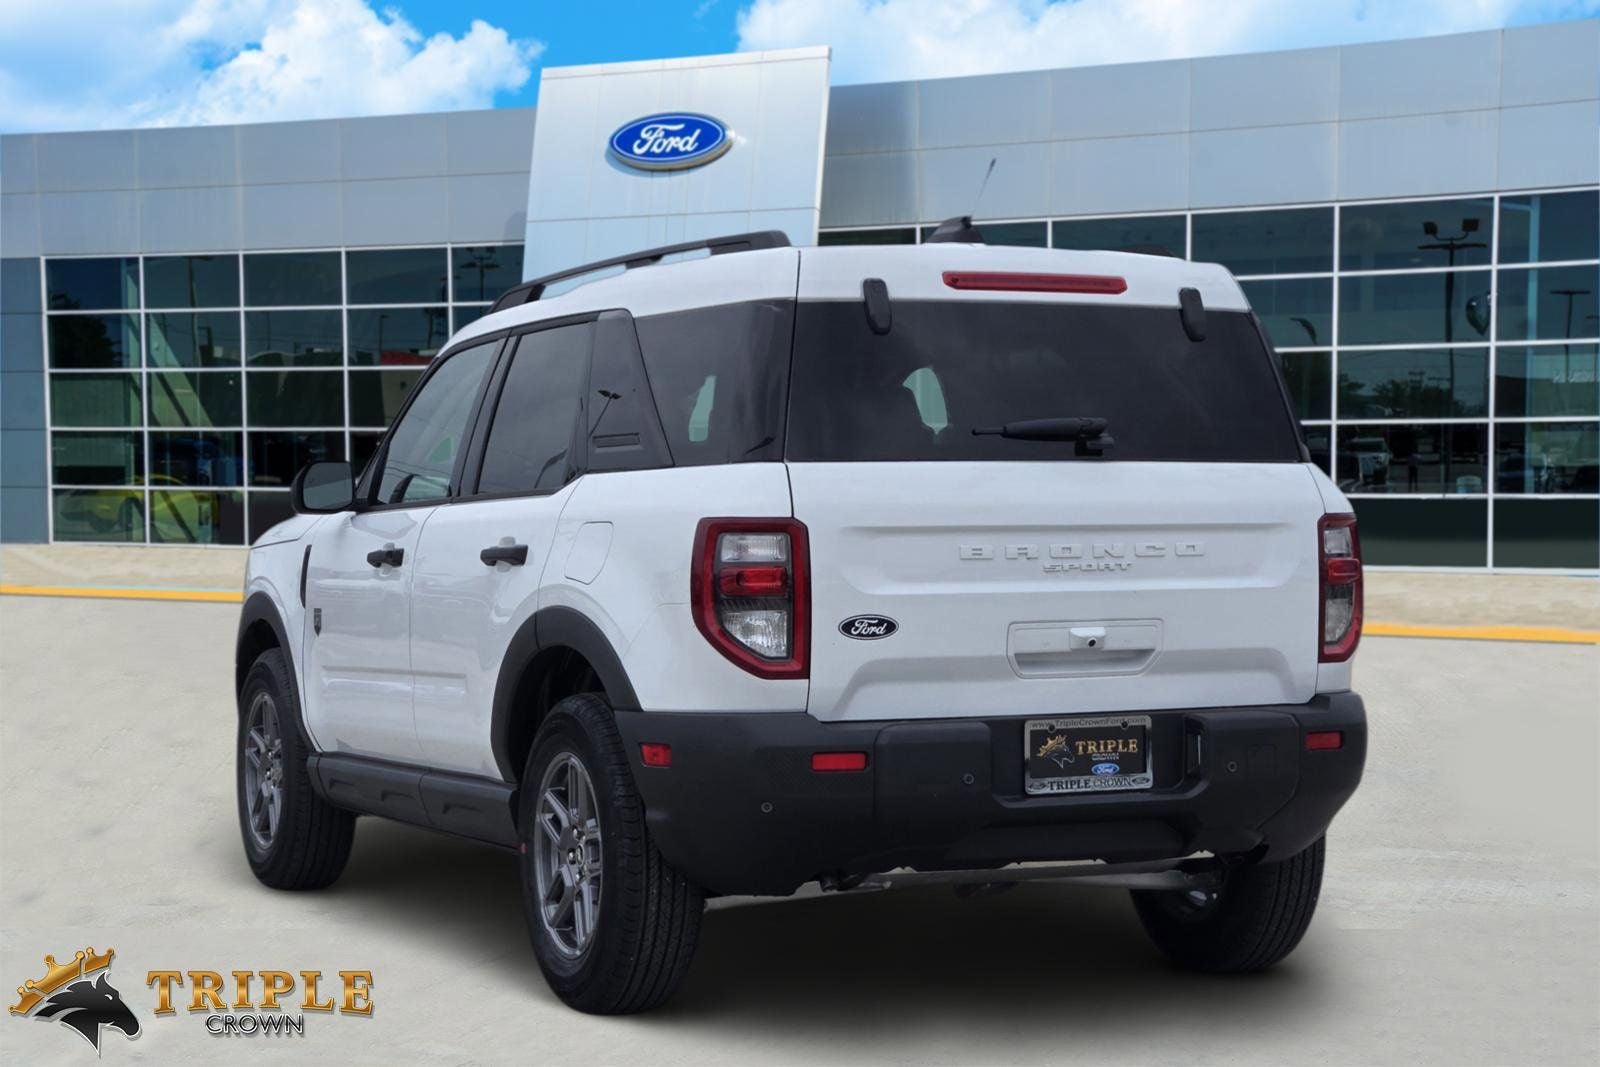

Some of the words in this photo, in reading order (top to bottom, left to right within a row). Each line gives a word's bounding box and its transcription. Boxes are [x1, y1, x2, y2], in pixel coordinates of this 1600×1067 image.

[633, 124, 701, 154] Ford
[959, 542, 1205, 560] BRONCO
[1043, 563, 1132, 573] SPORT
[851, 619, 888, 635] Ford
[1075, 739, 1138, 755] TRIPLE
[1048, 779, 1091, 790] TRIPLE
[1093, 776, 1131, 787] CROWN
